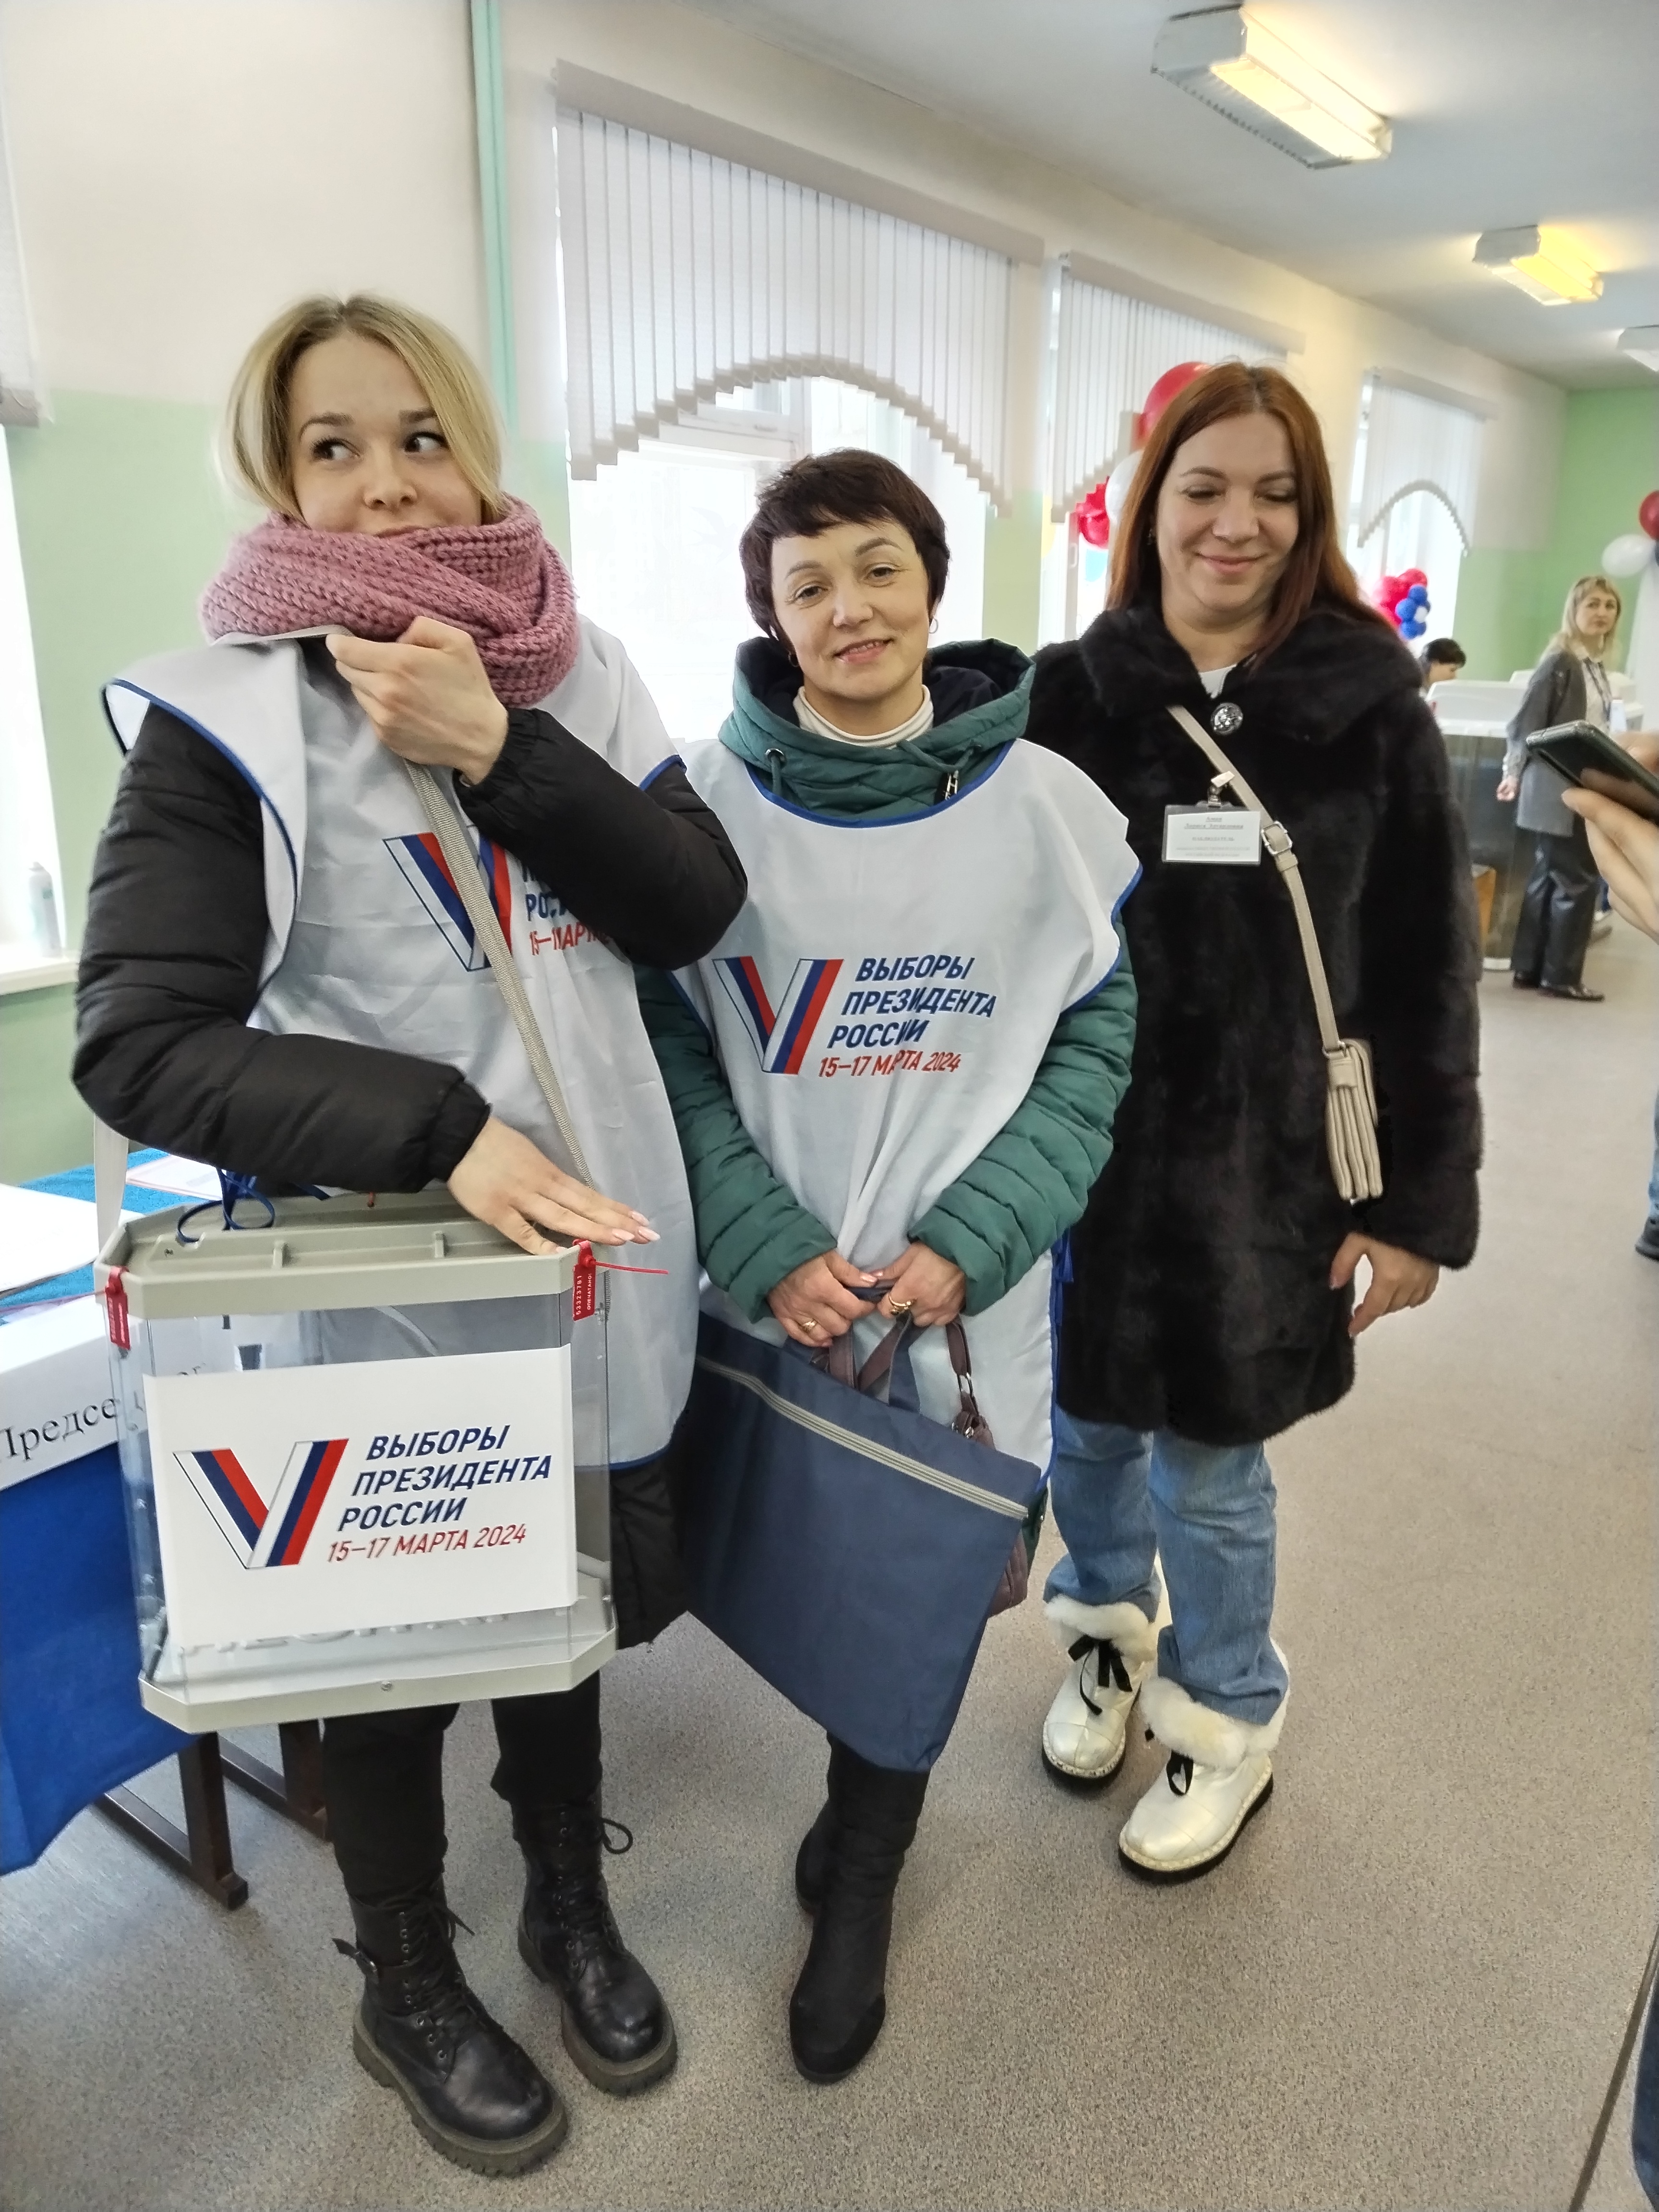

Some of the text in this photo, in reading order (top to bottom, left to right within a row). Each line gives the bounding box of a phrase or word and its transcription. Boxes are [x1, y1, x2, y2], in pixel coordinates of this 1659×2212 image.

[855, 955, 974, 982] ВЫБОРЫ
[842, 987, 997, 1018] ПРЕЗИДЕНТА
[828, 1019, 929, 1048] РОССИИ
[818, 1050, 961, 1078] 15–17 МАРТА 2024
[0, 1398, 119, 1461] Предсе
[366, 1425, 510, 1461] ВЫБОРЫ
[351, 1455, 550, 1496] ПРЕЗИДЕНТА
[338, 1498, 467, 1532] РОССИИ
[327, 1525, 527, 1563] 15–17 МАРТА 2024
